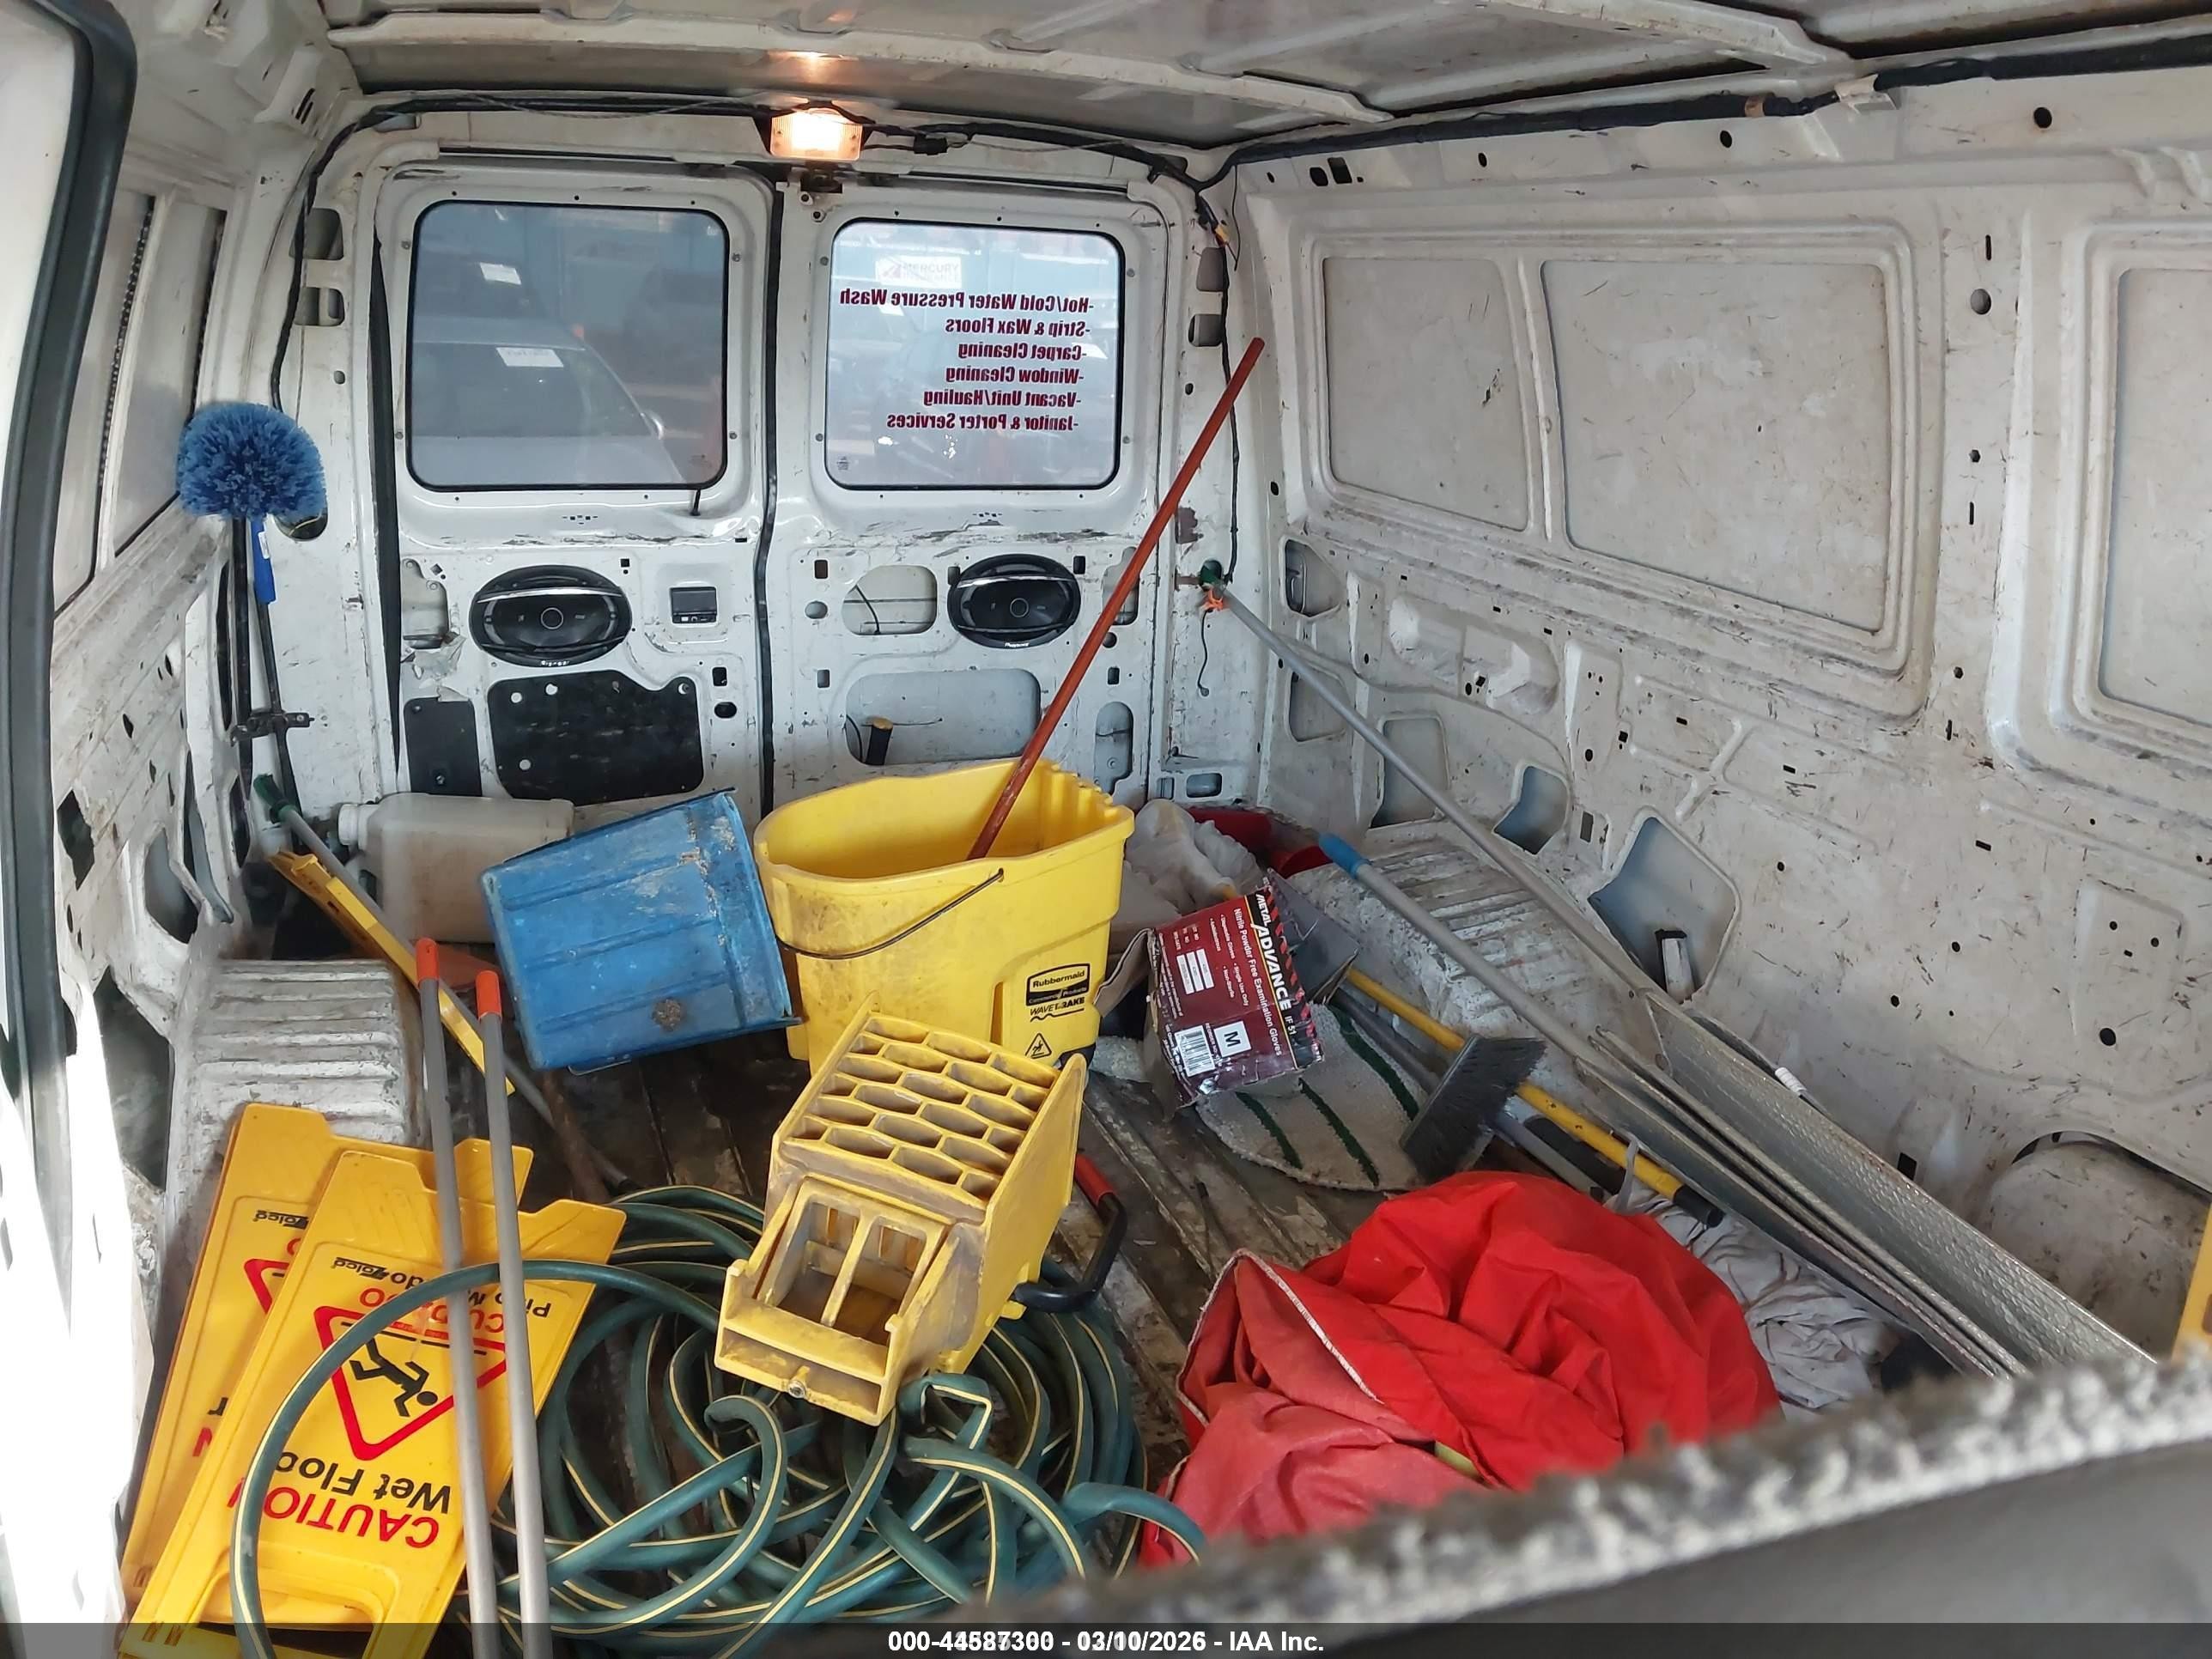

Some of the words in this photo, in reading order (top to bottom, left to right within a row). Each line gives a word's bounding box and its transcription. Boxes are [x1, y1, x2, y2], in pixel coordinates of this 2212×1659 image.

[1233, 908, 1246, 929] Nitrile
[1255, 892, 1272, 927] METAL
[1239, 929, 1255, 959] Powder
[1033, 970, 1085, 988] Rubbermaid
[1248, 958, 1260, 977] Free
[1249, 924, 1291, 1012] ADVANCE
[1233, 965, 1243, 983] Single
[1240, 994, 1250, 1007] Only
[1254, 978, 1275, 1027] Examination
[1284, 1015, 1293, 1024] IF
[1287, 1024, 1297, 1036] 51
[1224, 1030, 1241, 1048] M
[1268, 1027, 1284, 1056] Gloves
[275, 1451, 366, 1497] Floo
[374, 1473, 452, 1515] Wet
